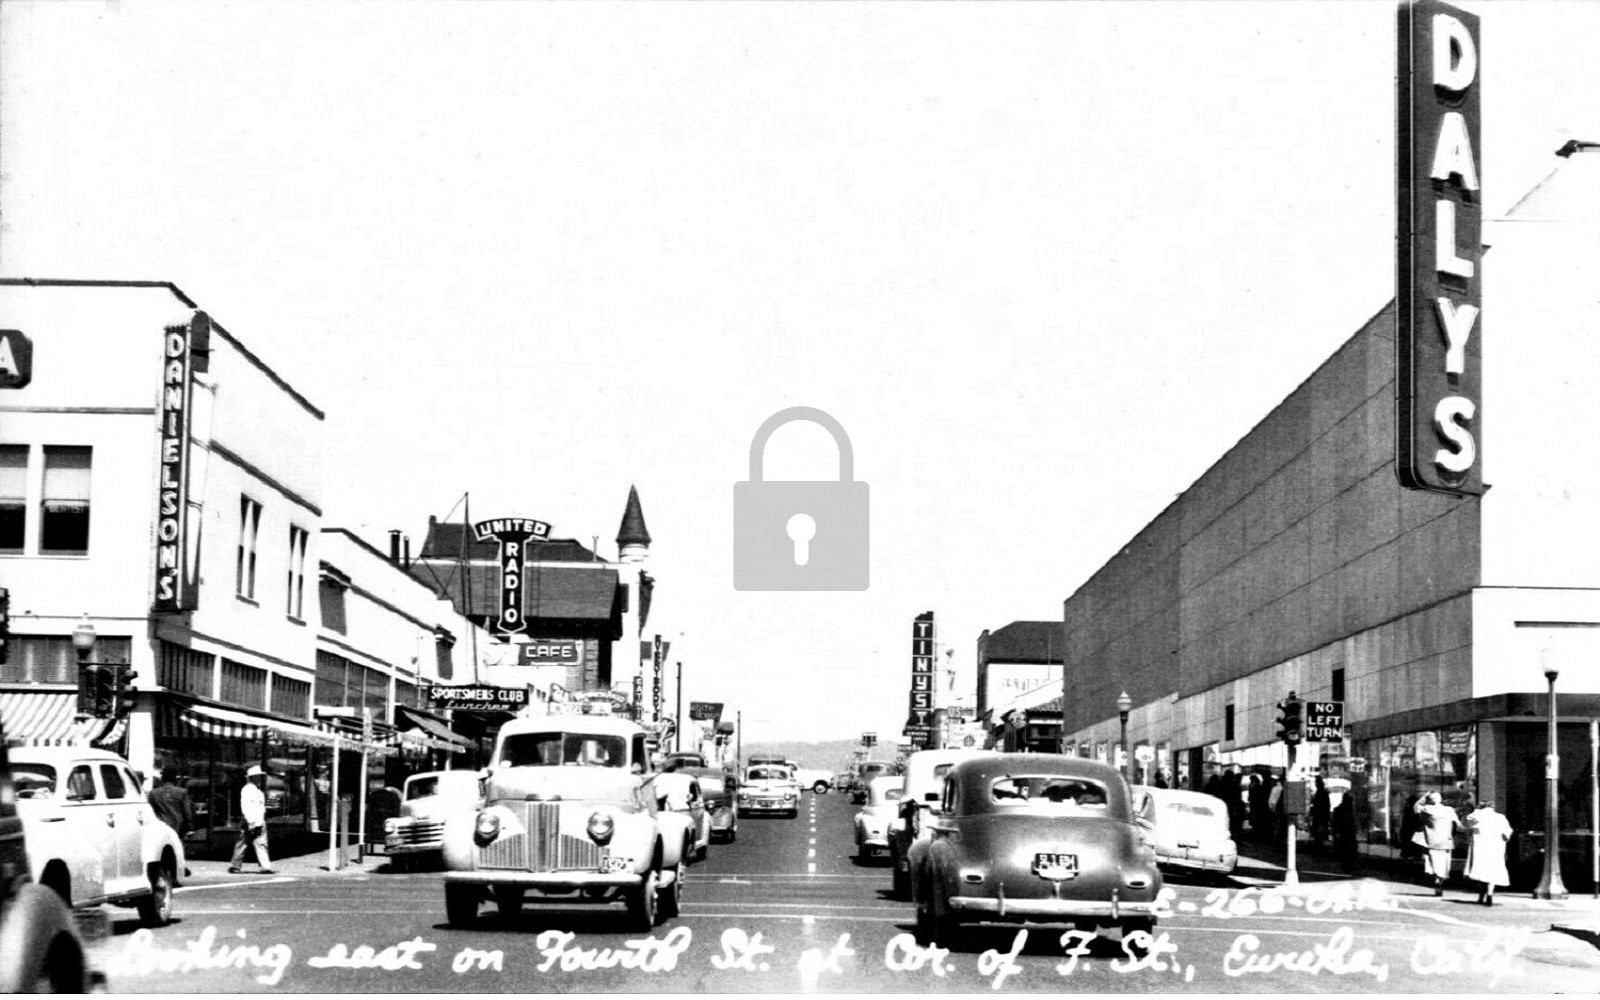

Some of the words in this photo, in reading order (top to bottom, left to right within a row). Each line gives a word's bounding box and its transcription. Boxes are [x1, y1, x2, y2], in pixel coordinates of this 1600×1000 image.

[1429, 13, 1480, 473] DALYS
[157, 332, 185, 600] DANIELSON'S
[480, 519, 547, 537] UNITED
[505, 541, 519, 623] RADIO
[525, 644, 573, 658] CAFE
[915, 622, 930, 708] TINYS
[498, 690, 524, 702] CLUB
[1315, 703, 1334, 713] NO
[1308, 716, 1341, 725] LEFT
[1308, 727, 1342, 738] TURN
